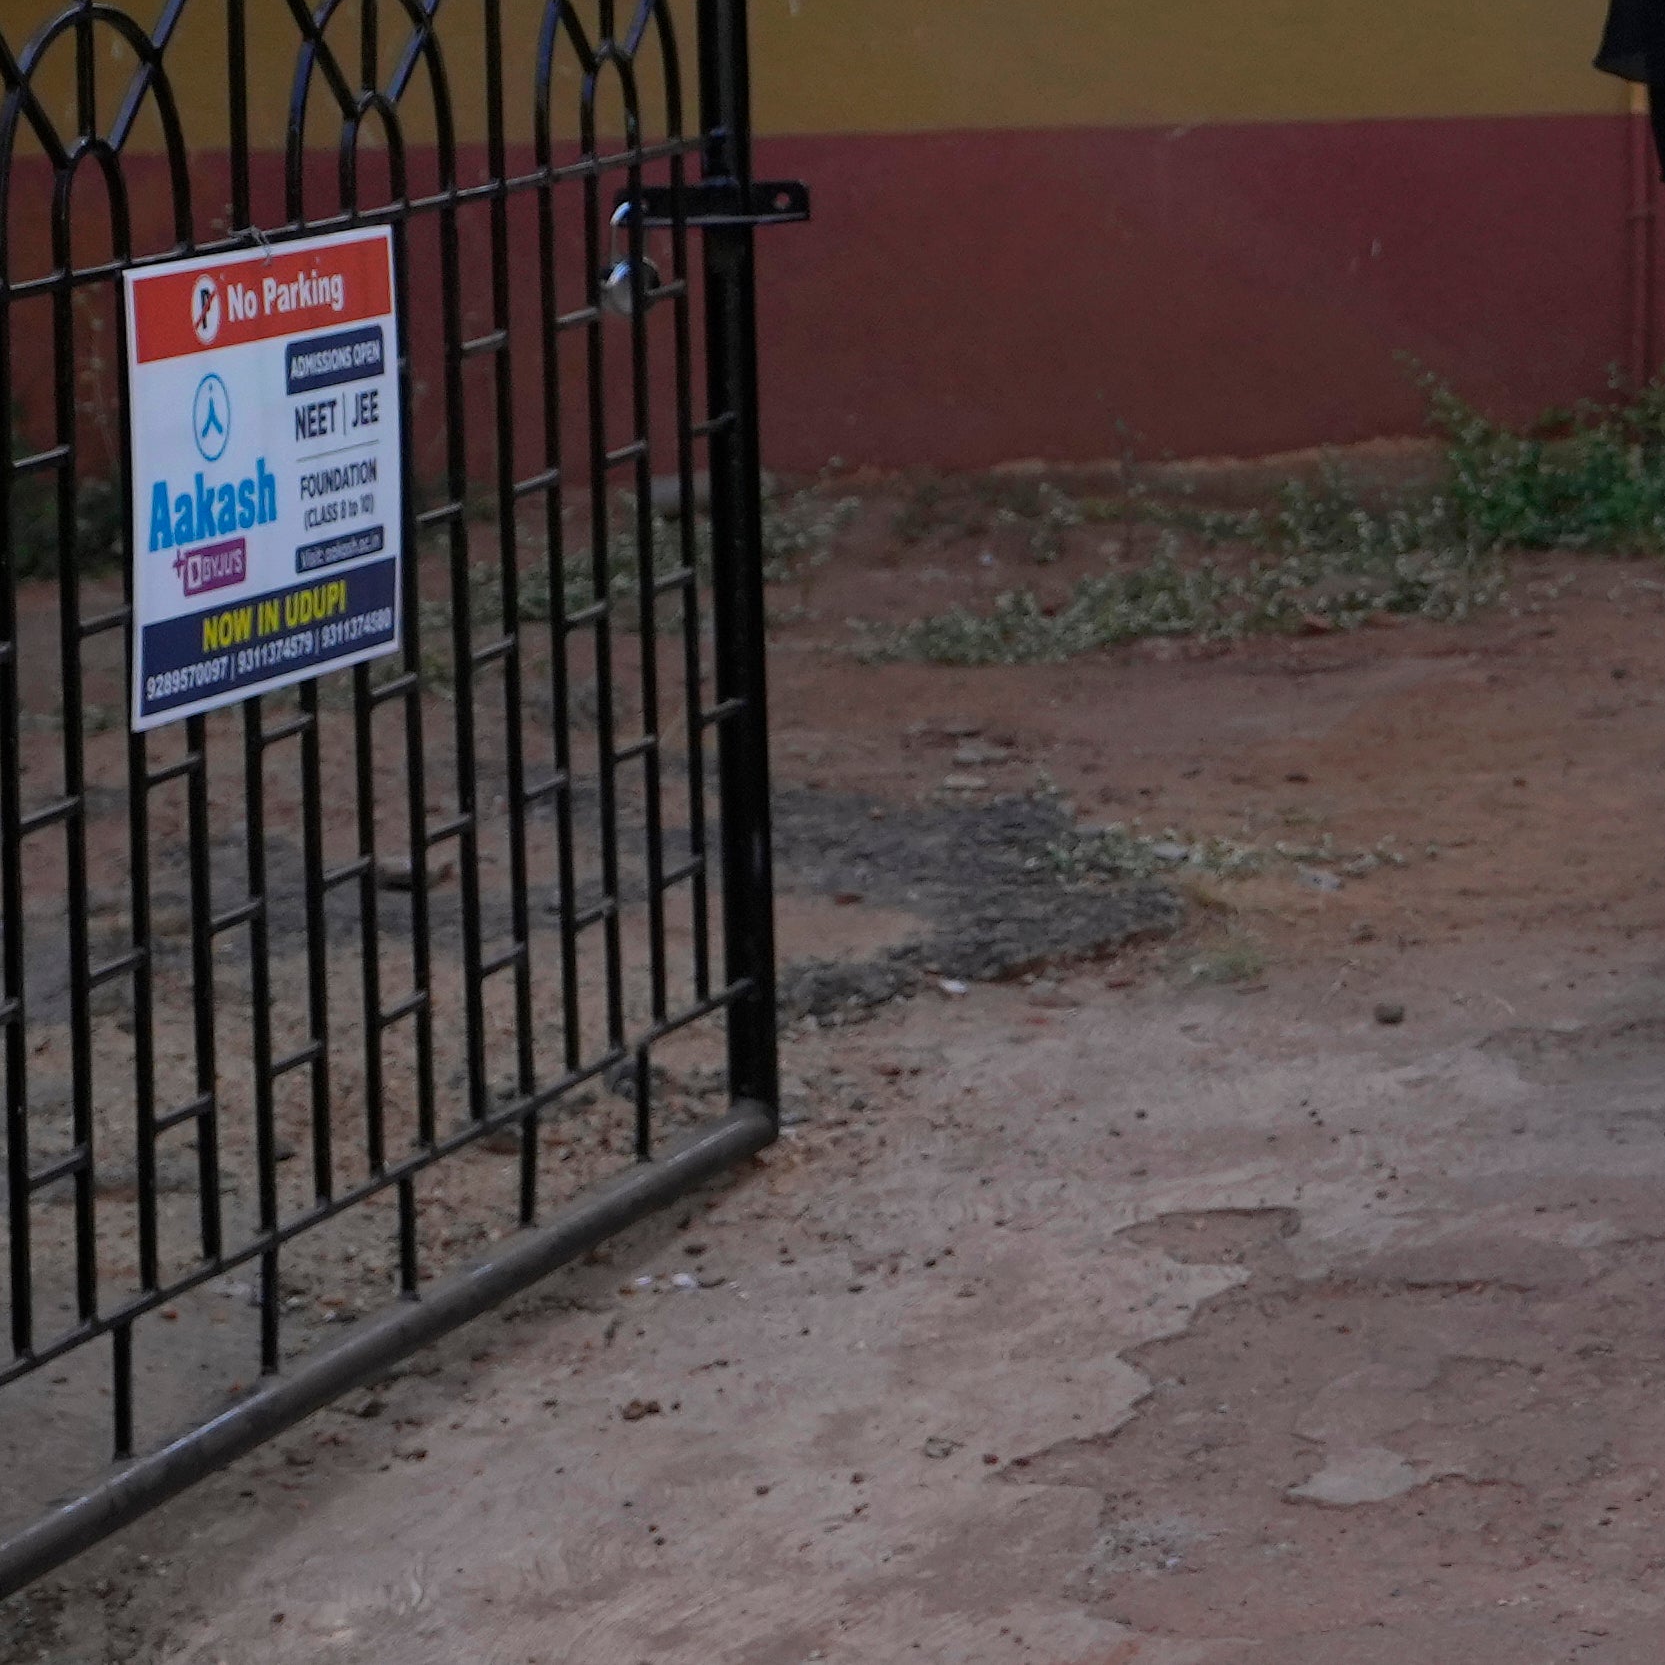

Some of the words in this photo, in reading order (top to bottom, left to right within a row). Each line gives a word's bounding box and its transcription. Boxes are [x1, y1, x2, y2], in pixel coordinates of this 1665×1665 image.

[227, 284, 257, 322] No
[262, 268, 345, 313] Parking
[290, 346, 352, 380] ADMISSIONS
[352, 340, 381, 365] OPEN
[294, 397, 337, 442] NEET
[351, 388, 379, 427] JEE
[148, 456, 278, 553] Aakash
[299, 457, 377, 500] FOUNDATION
[303, 500, 338, 532] (CLASS
[348, 498, 359, 518] to
[202, 605, 254, 654] NOW
[256, 599, 281, 637] IN
[284, 579, 348, 627] UDUPI
